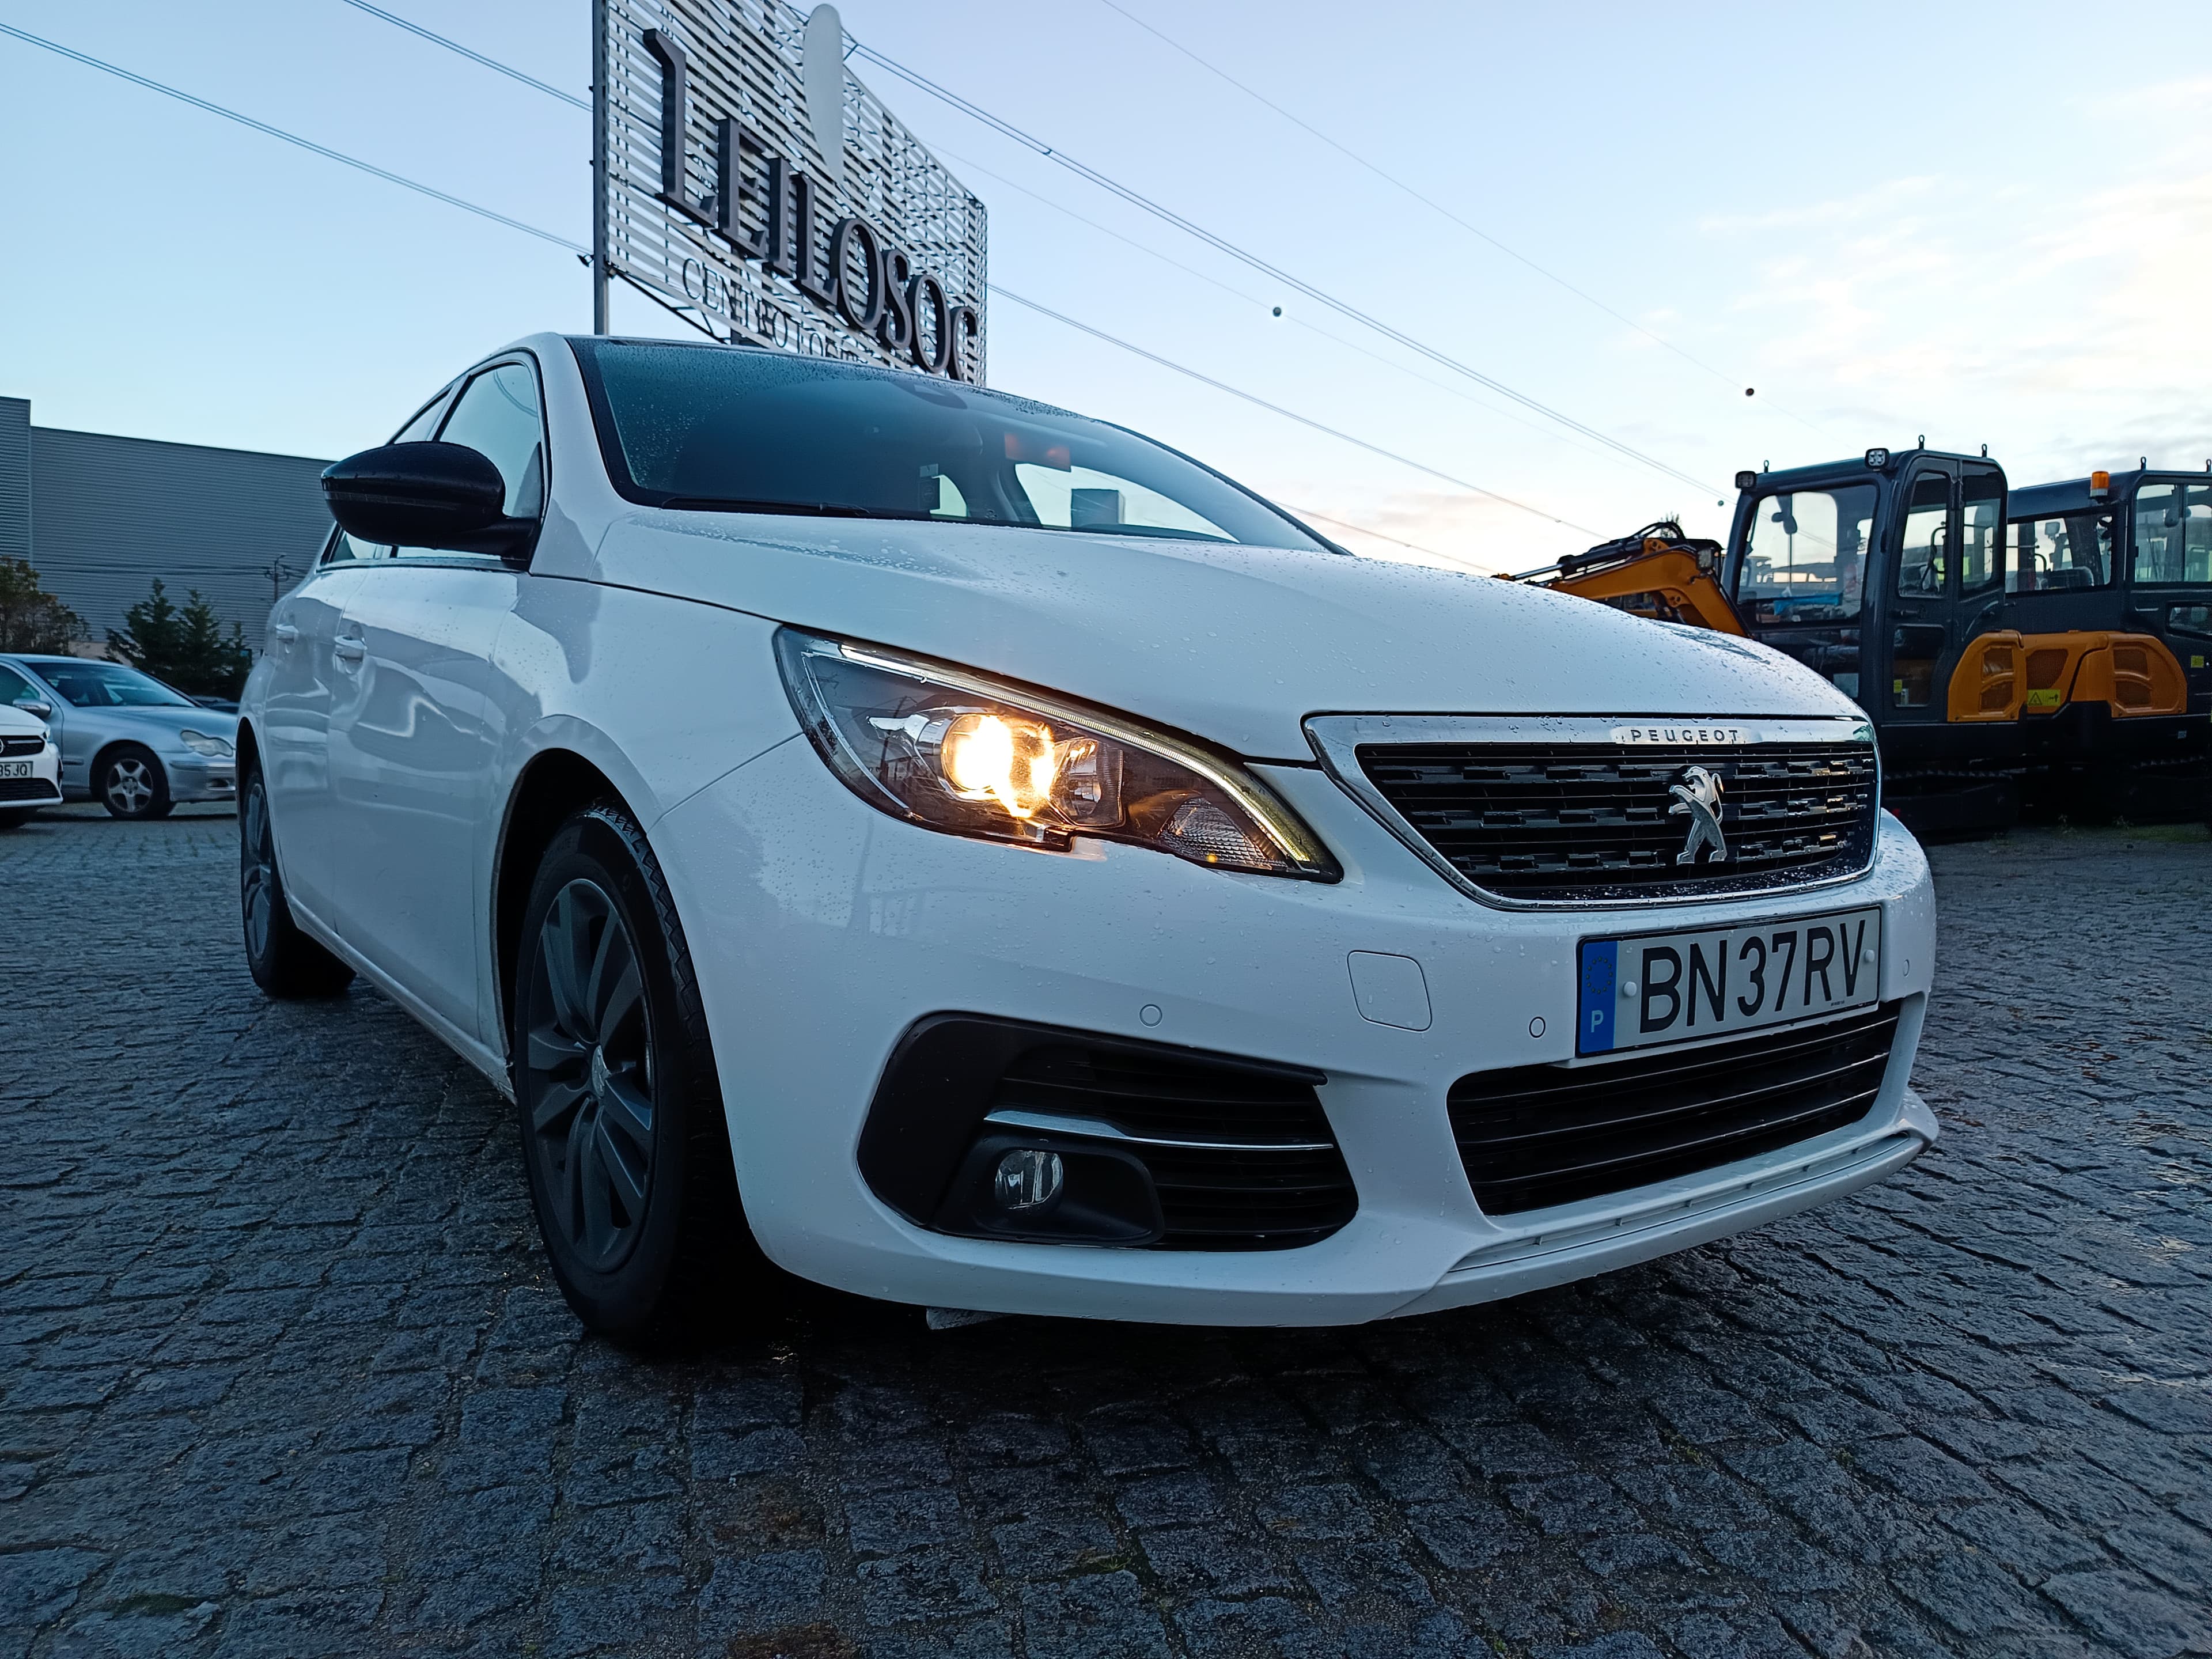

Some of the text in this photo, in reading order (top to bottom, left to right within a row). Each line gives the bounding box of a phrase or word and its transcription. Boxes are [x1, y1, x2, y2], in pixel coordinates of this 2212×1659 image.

[643, 28, 978, 381] LEILOSOC
[1630, 729, 1738, 742] PEUGEOT
[1591, 919, 1866, 1033] P BN37RV
